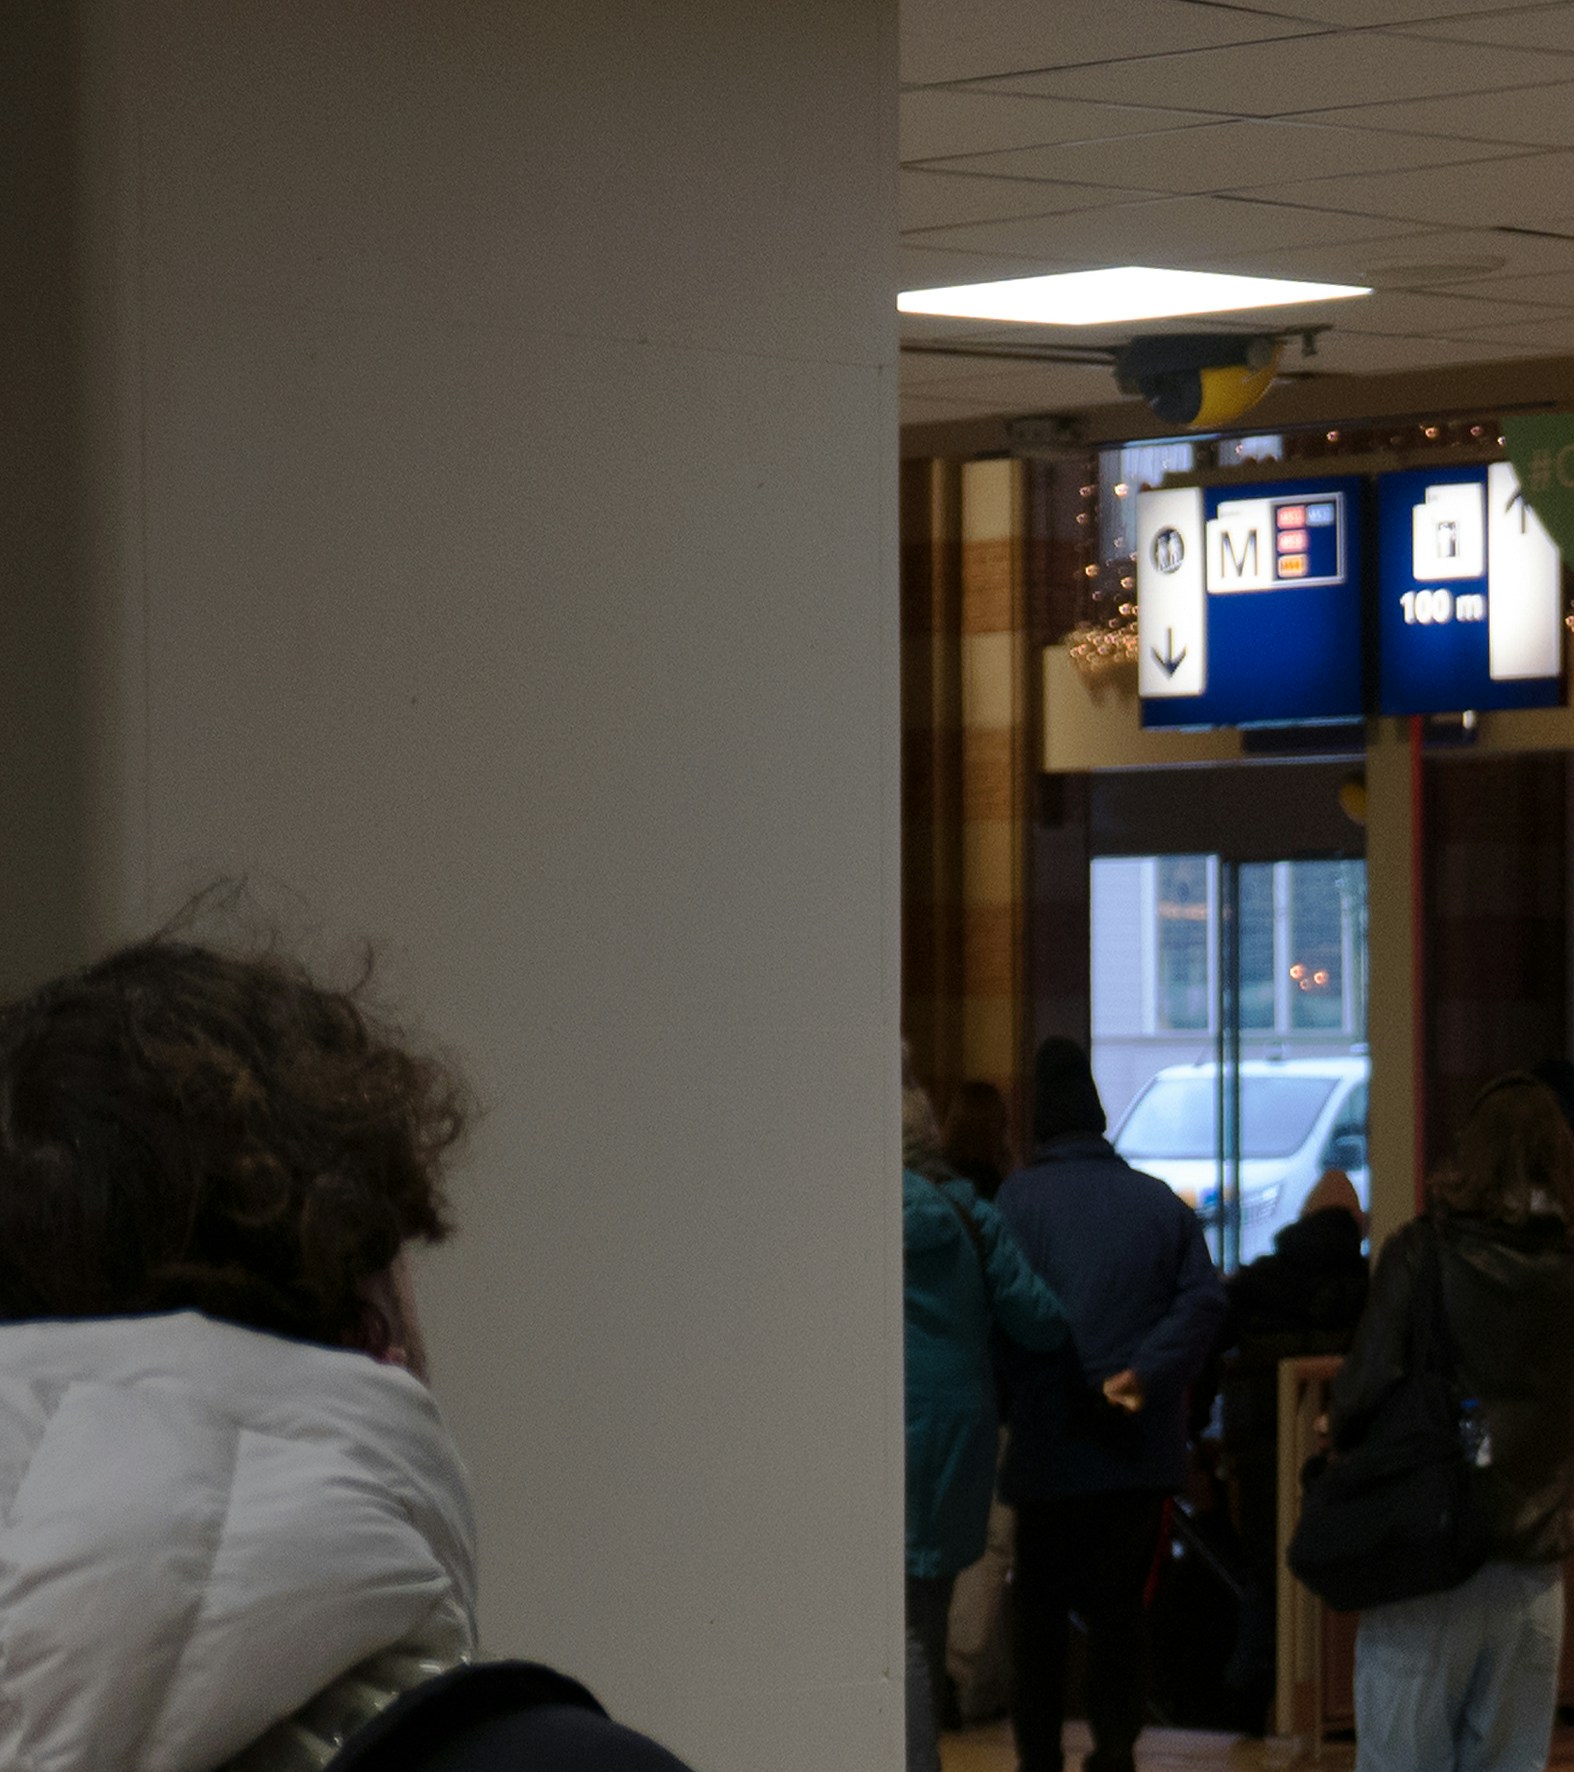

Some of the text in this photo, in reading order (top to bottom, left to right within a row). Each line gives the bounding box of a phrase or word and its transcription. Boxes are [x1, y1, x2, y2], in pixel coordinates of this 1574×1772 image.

[1221, 528, 1258, 578] M
[1399, 588, 1486, 626] 100 m
